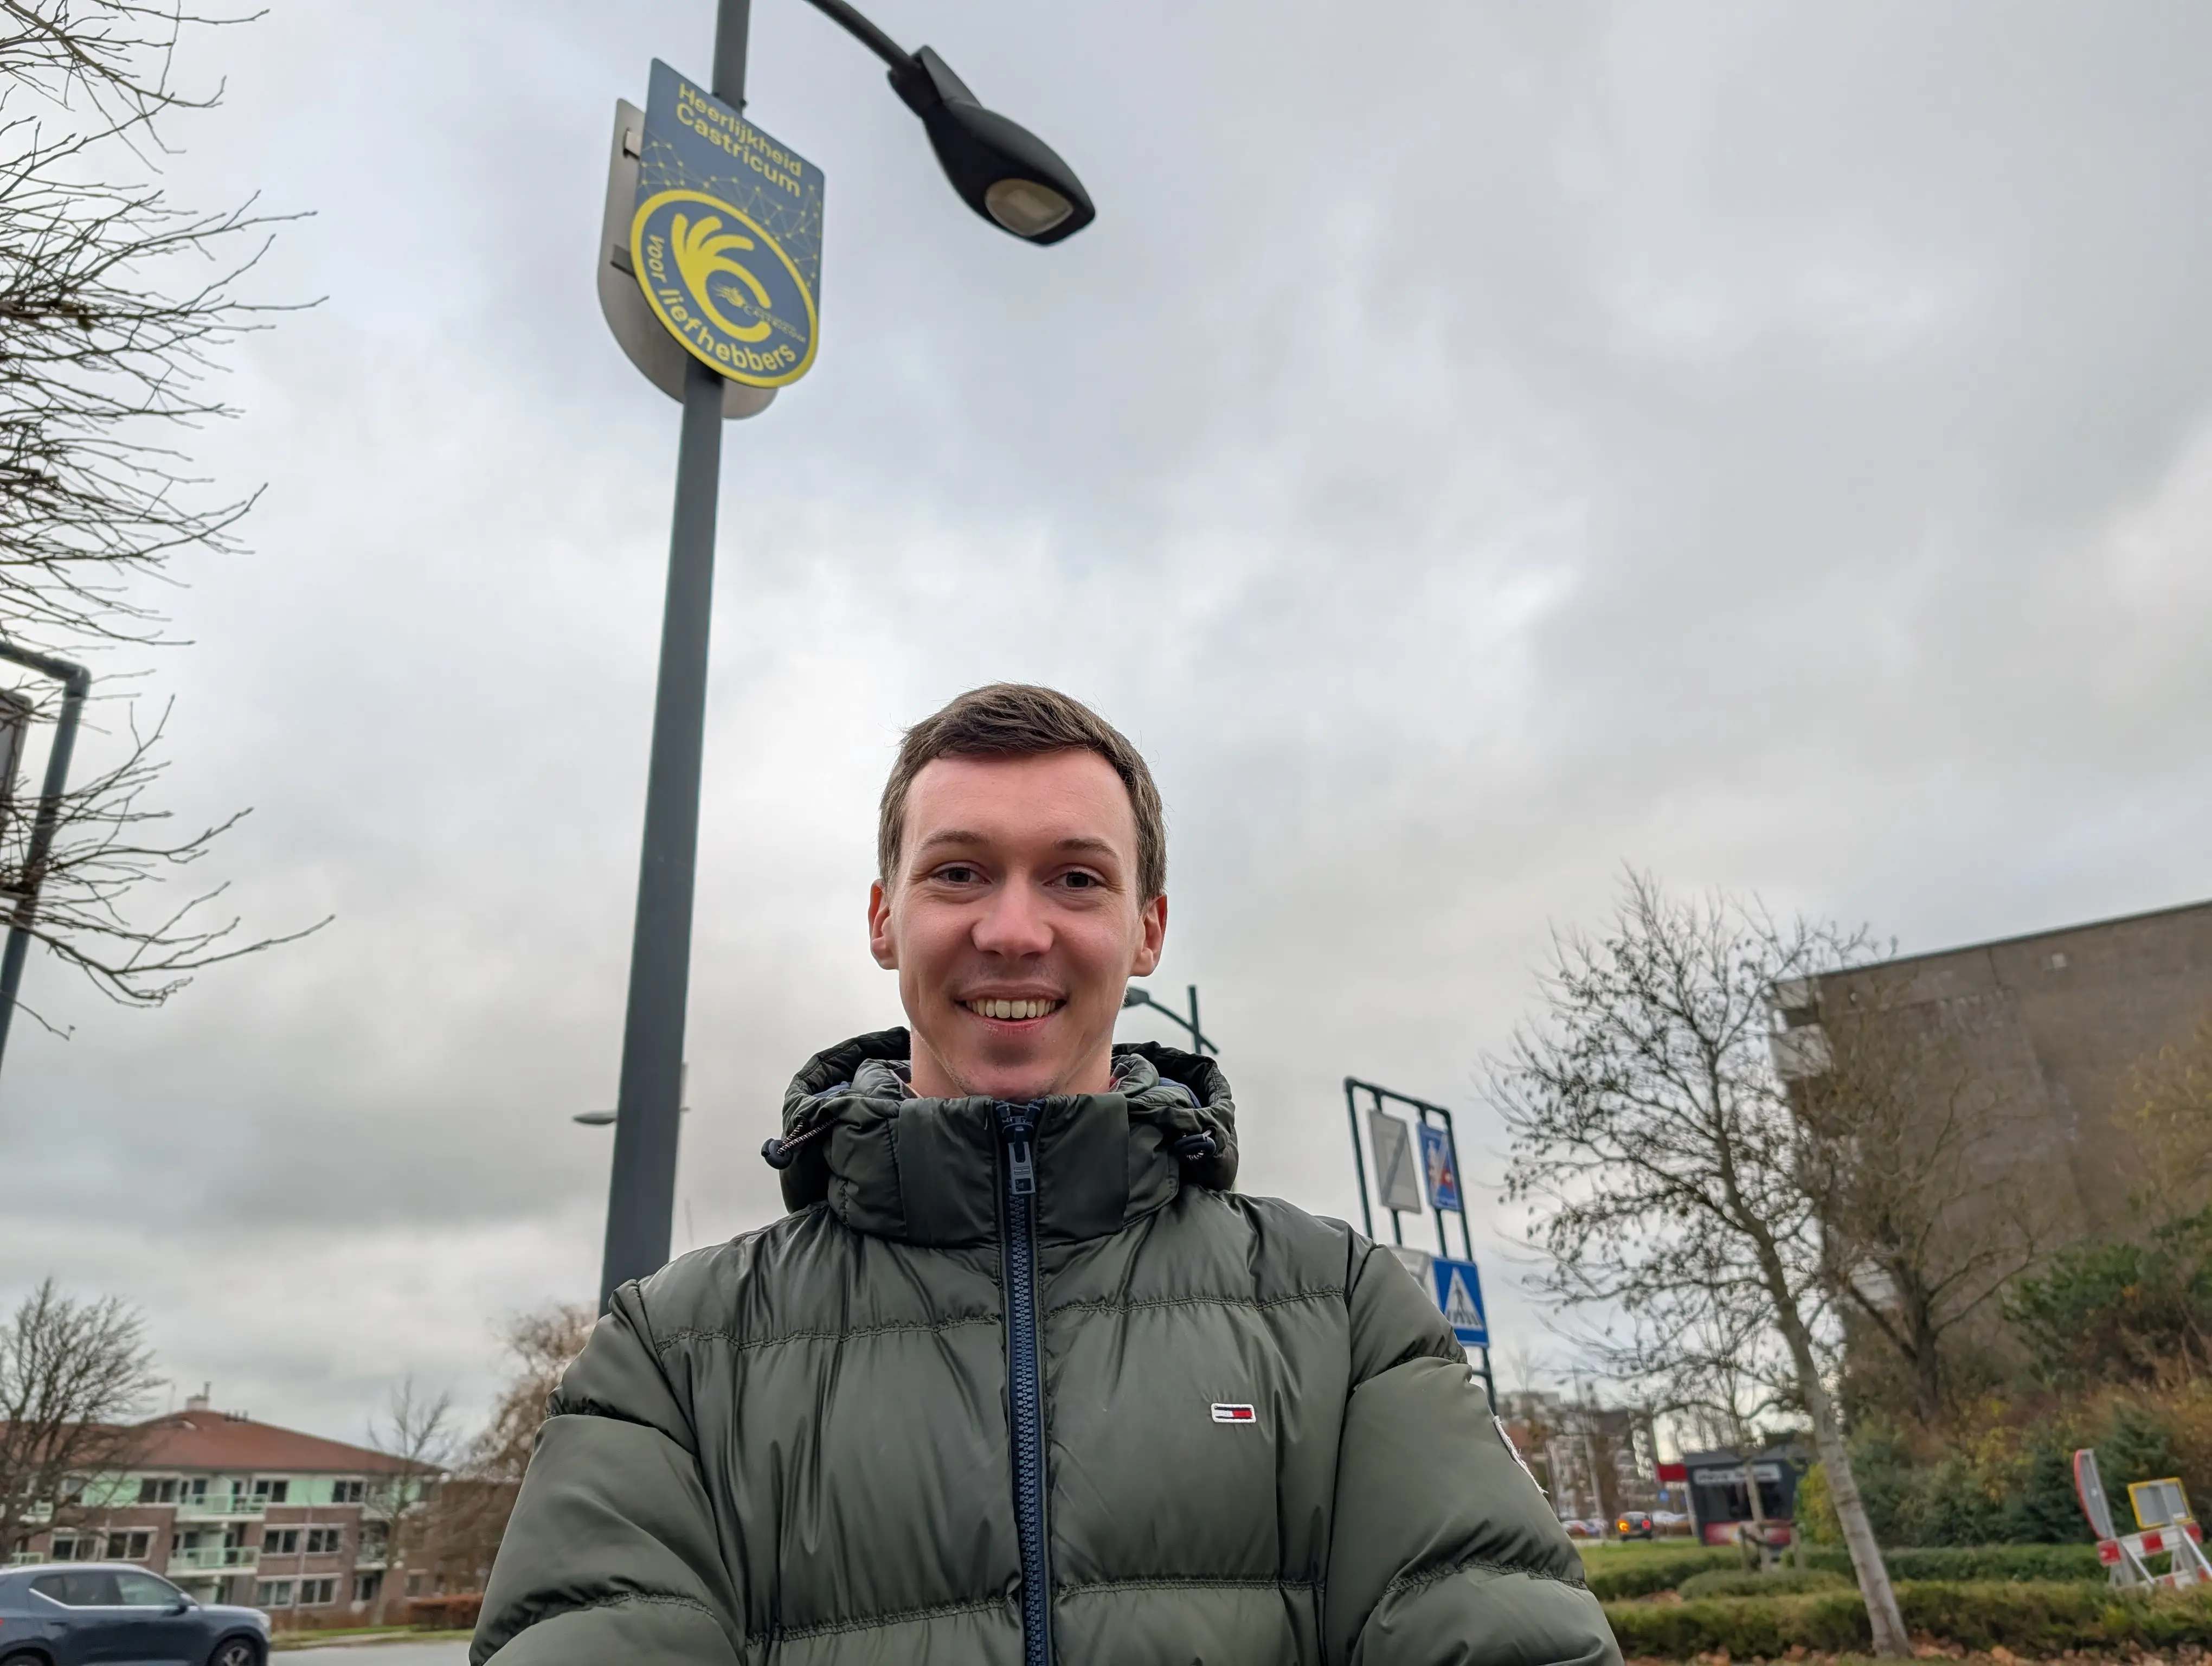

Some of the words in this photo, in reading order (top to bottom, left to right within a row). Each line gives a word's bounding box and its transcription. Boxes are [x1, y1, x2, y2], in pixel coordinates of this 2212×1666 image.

[676, 102, 801, 198] Castricum
[679, 82, 802, 178] Heerlijkheid
[646, 234, 667, 283] voor
[658, 289, 796, 371] liefhebbers
